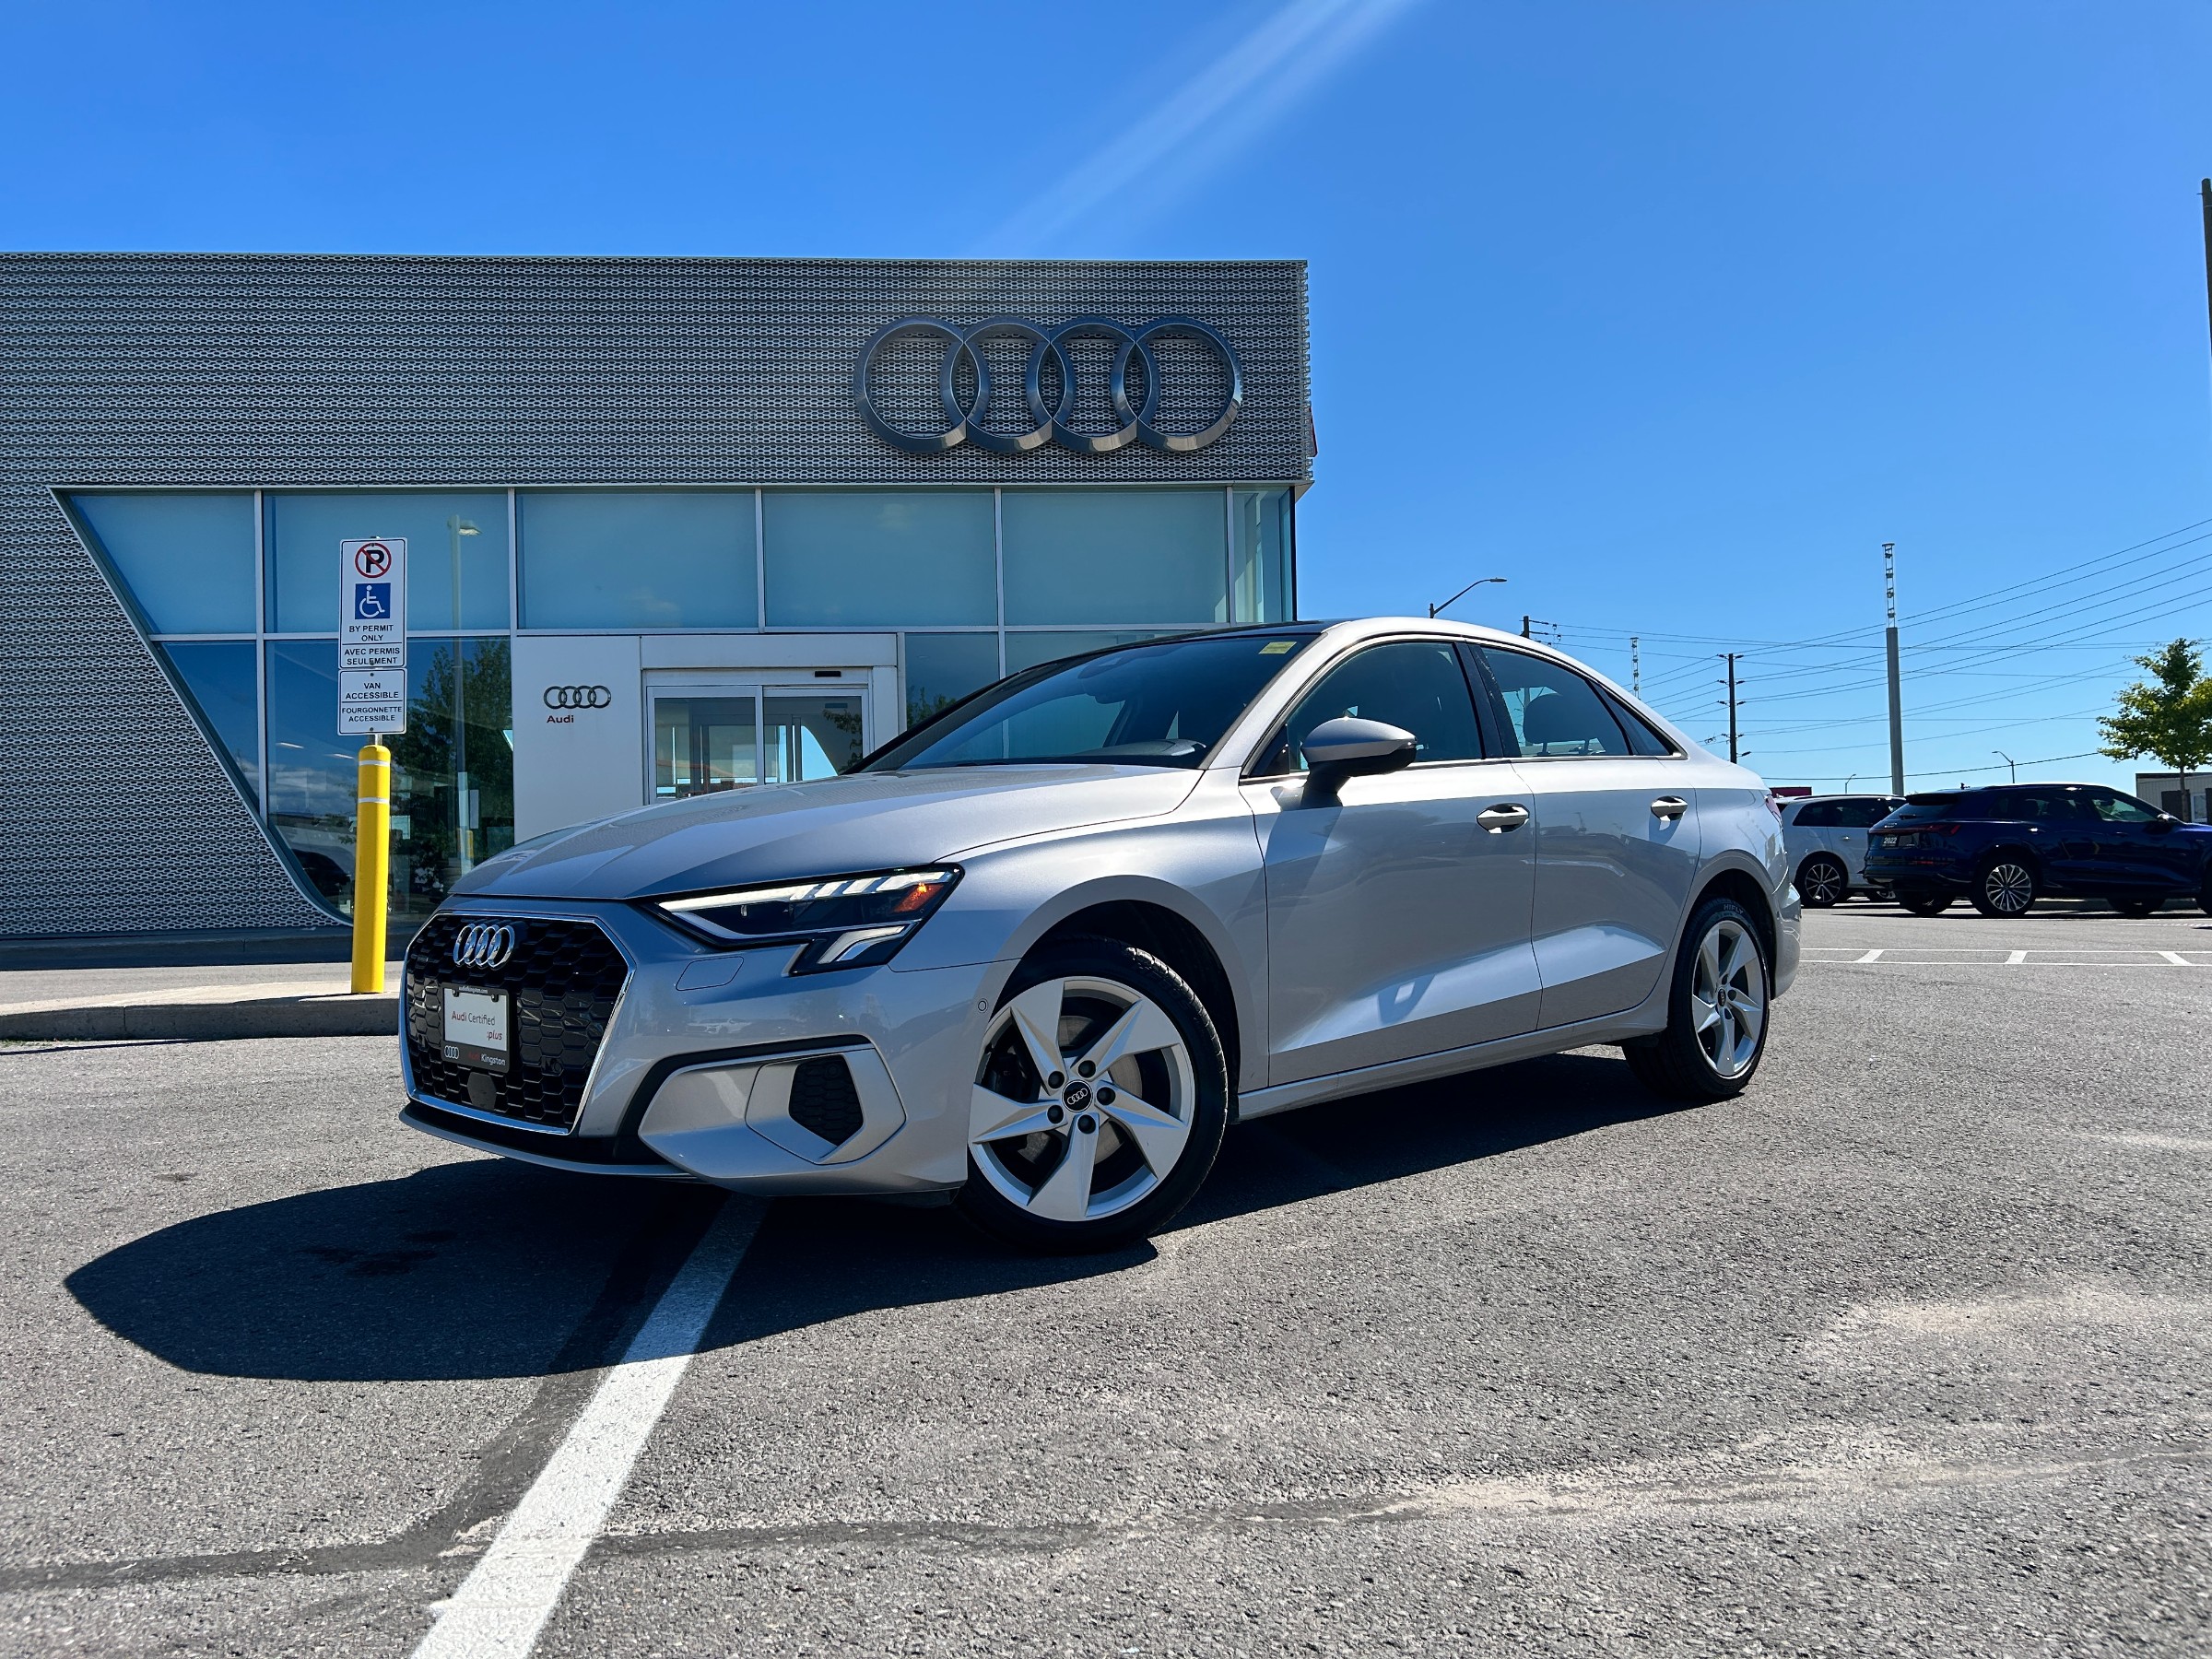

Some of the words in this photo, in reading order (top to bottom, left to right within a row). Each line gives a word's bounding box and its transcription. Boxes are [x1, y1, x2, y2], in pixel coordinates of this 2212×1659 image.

[362, 624, 394, 632] PERMIT
[369, 647, 400, 655] PERMIS
[347, 657, 397, 665] SEULEMENT
[345, 691, 399, 700] ACCESSIBLE
[342, 706, 402, 714] FOURGONNETTE
[348, 714, 395, 723] ACCESSIBLE
[547, 714, 574, 724] Audi
[1724, 904, 1744, 914] HIFLY
[452, 1010, 466, 1021] Audi
[468, 1012, 496, 1026] Certified
[481, 1053, 506, 1066] Kingston
